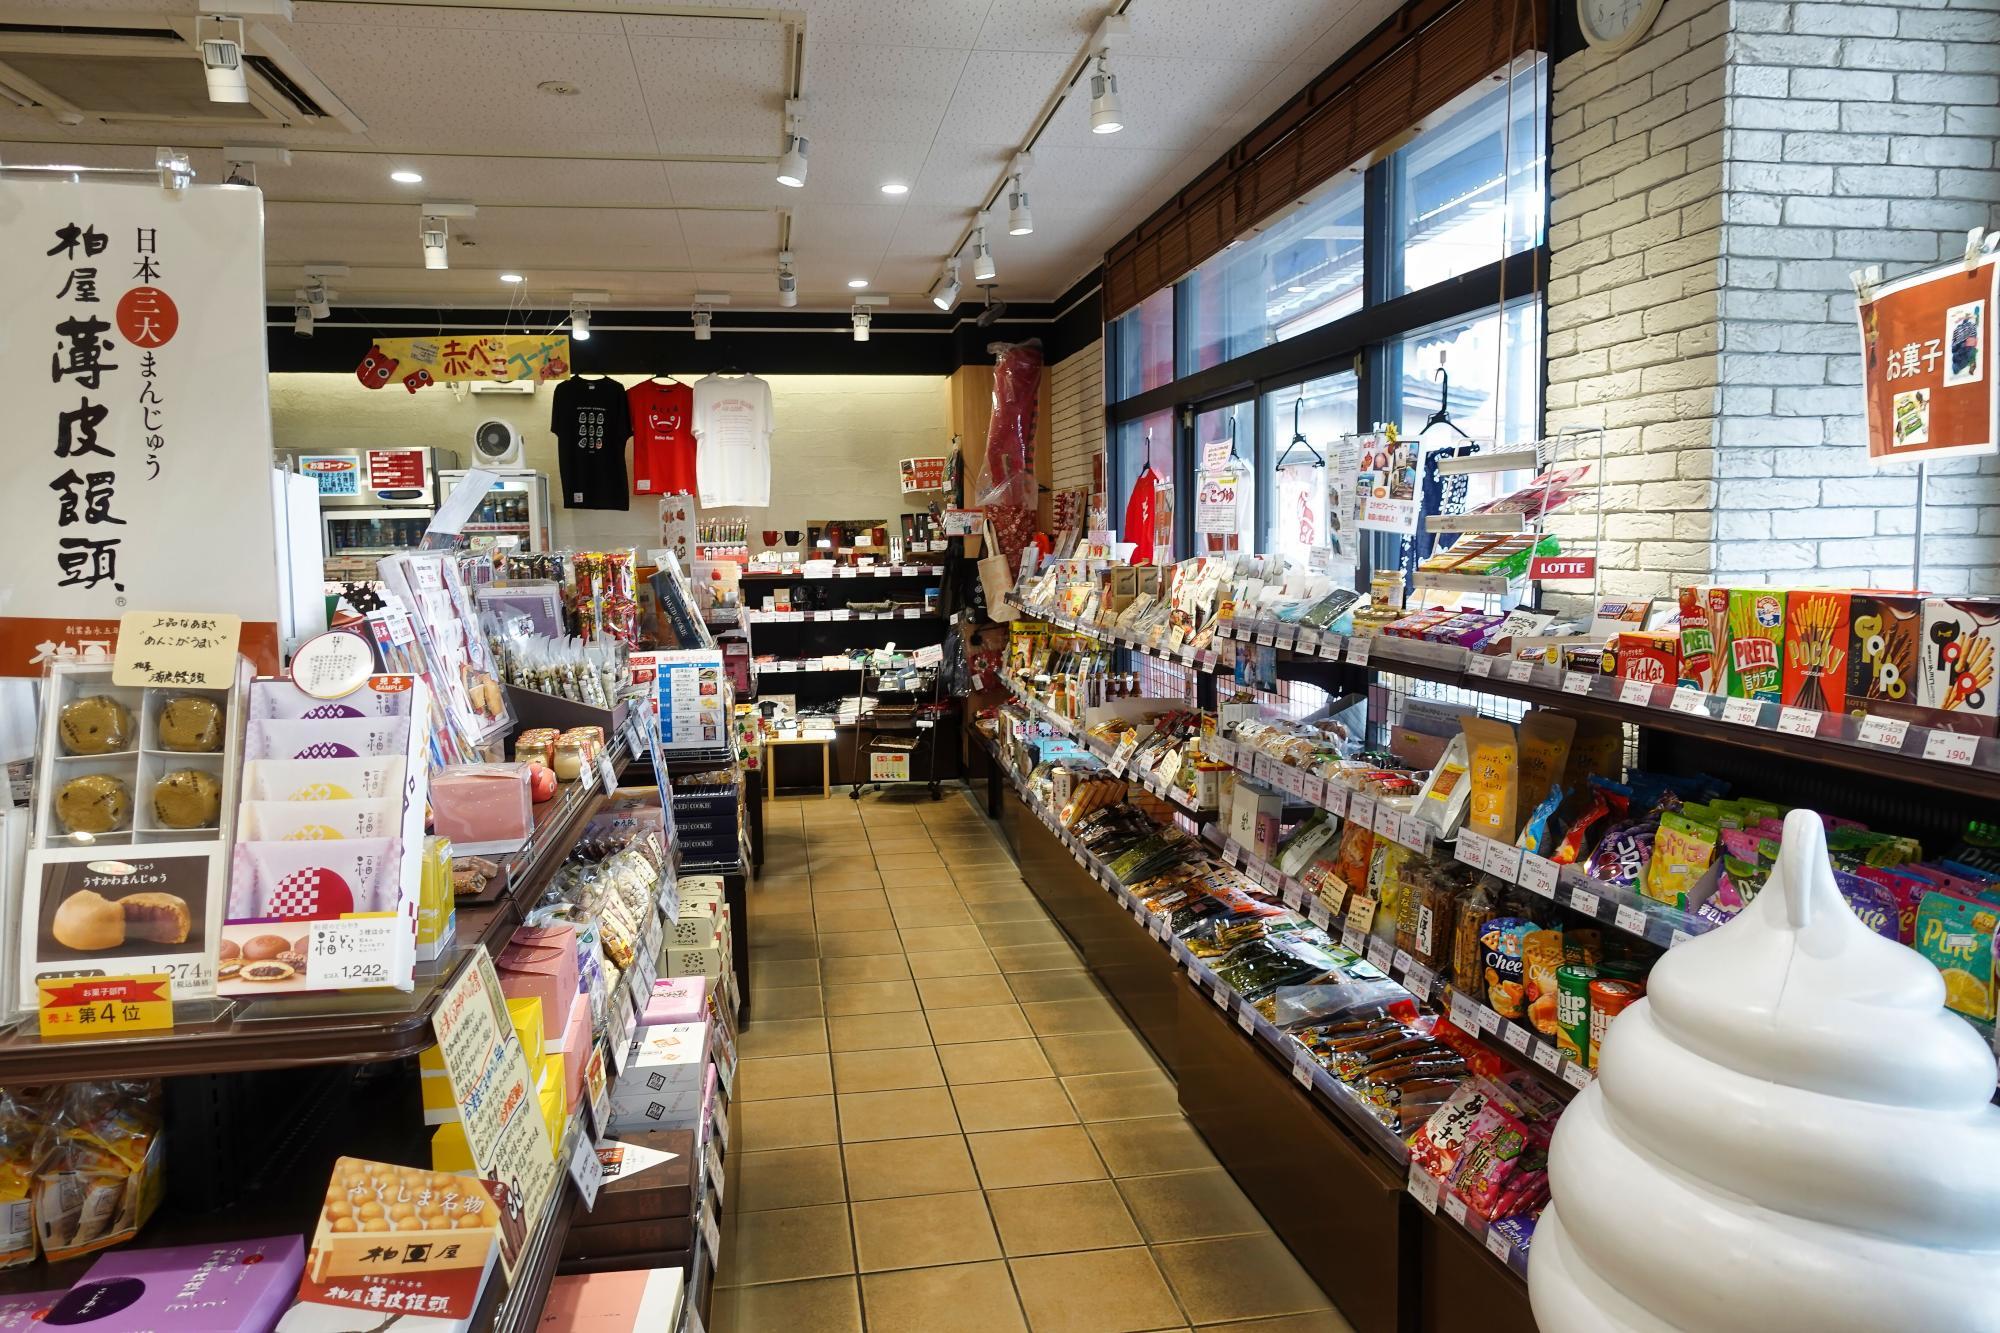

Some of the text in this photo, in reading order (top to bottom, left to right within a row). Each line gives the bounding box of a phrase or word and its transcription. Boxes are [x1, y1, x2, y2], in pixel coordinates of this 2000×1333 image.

[131, 227, 163, 481] 日本三大まんじゅう
[1887, 338, 1943, 381] お菓子
[46, 222, 127, 592] 柏屋薄皮饅頭
[1209, 488, 1234, 503] こづゆ
[1540, 562, 1586, 574] LOTTE
[1679, 615, 1709, 626] Tomato
[1682, 631, 1713, 654] PRETZ
[1734, 640, 1775, 668] PRETZ
[1787, 640, 1845, 675] POCKY
[375, 684, 404, 692] SAMPLE
[83, 873, 167, 888] うすかわまんじゅう
[82, 986, 127, 997] お菓子部門
[79, 1003, 141, 1024] 第4位
[349, 1181, 486, 1214] ふくしま名物
[324, 1284, 450, 1314] 柏屋薄皮饅頭
